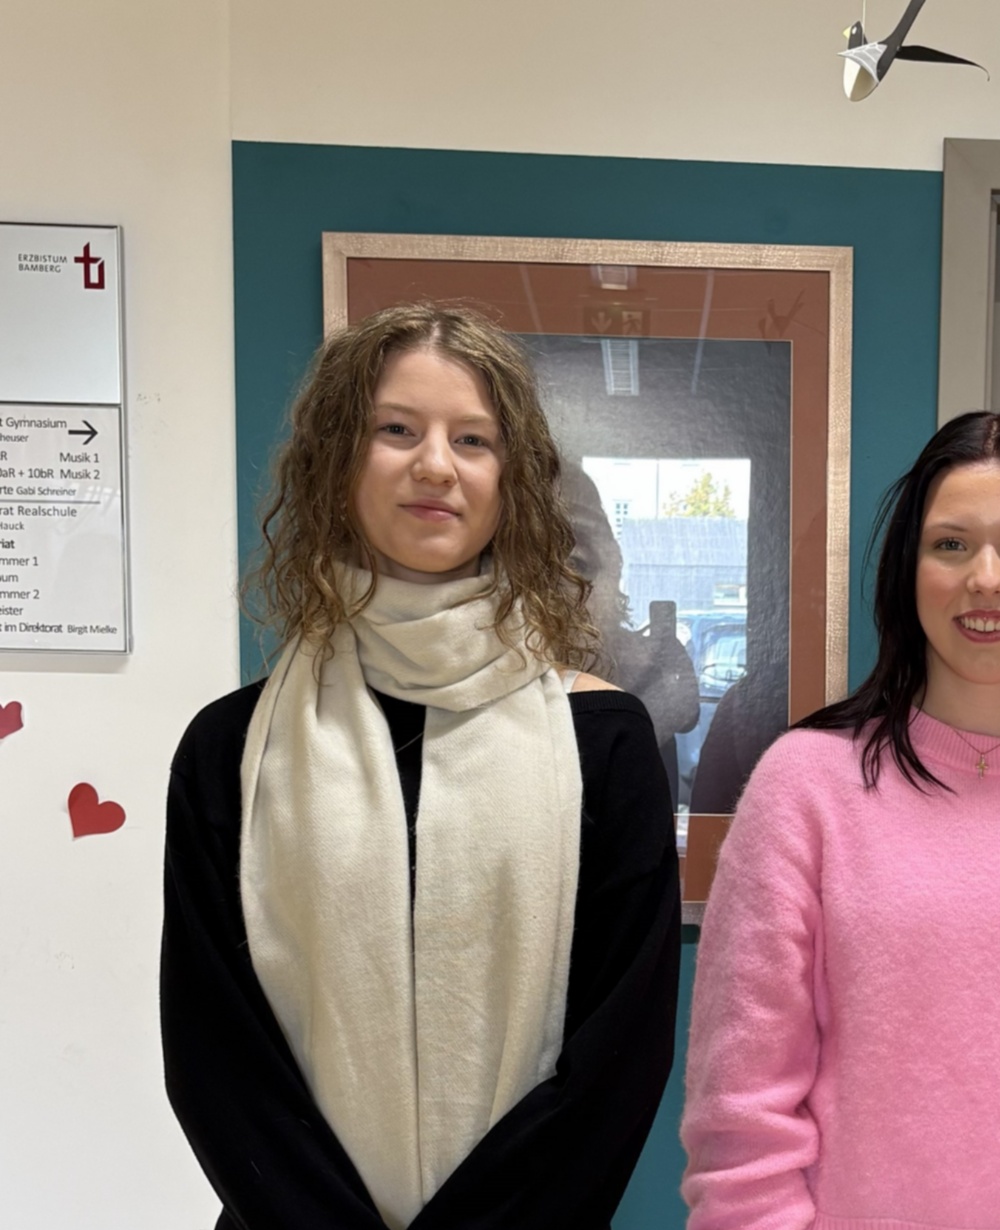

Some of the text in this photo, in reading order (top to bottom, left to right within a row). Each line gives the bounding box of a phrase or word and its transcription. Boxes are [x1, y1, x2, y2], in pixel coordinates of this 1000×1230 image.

[18, 253, 68, 264] ERZBISTUM
[18, 263, 61, 274] BAMBERG
[6, 416, 67, 430] Gymnasium
[0, 433, 29, 442] heuser
[60, 452, 99, 463] Musik 1
[28, 468, 54, 479] 10bR
[60, 468, 100, 480] Musik 2
[0, 485, 76, 497] rte Gabi Schreiner
[0, 505, 77, 517] rat Realschule
[33, 556, 38, 566] 1
[33, 589, 40, 600] 2
[5, 623, 17, 633] im
[19, 622, 63, 634] Direktorat
[67, 624, 88, 635] Birgit
[90, 624, 117, 634] Mielke
